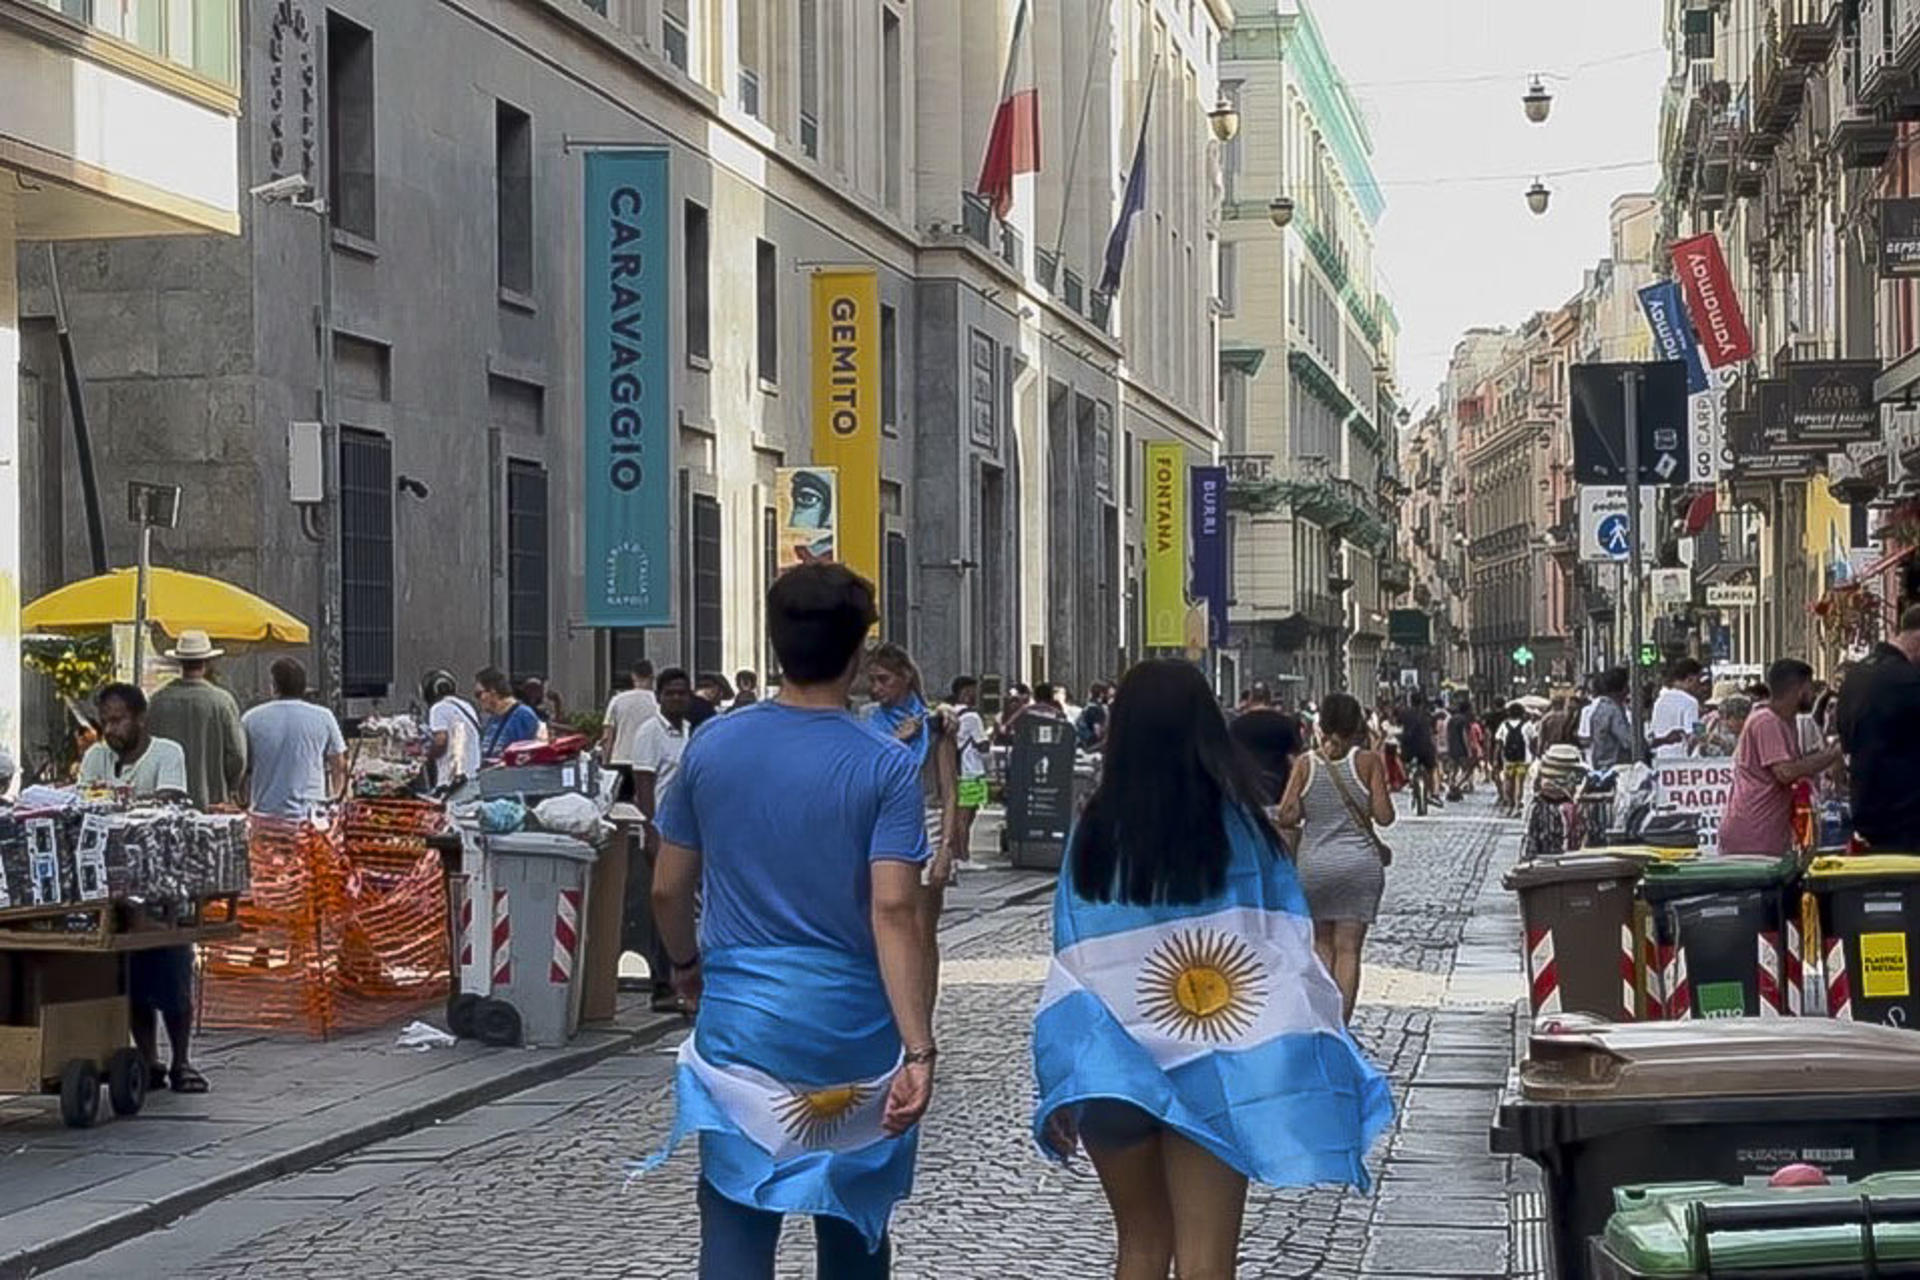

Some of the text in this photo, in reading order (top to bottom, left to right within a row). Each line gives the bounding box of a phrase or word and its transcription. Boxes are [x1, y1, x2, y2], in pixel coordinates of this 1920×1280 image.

[609, 187, 643, 492] CARAVAGGIO
[1687, 253, 1737, 357] yamamay
[830, 298, 858, 435] GEMITO
[1157, 458, 1172, 553] FONTANA
[1203, 480, 1216, 535] BURRI
[1697, 452, 1711, 478] GO
[1661, 768, 1733, 787] DEPOS
